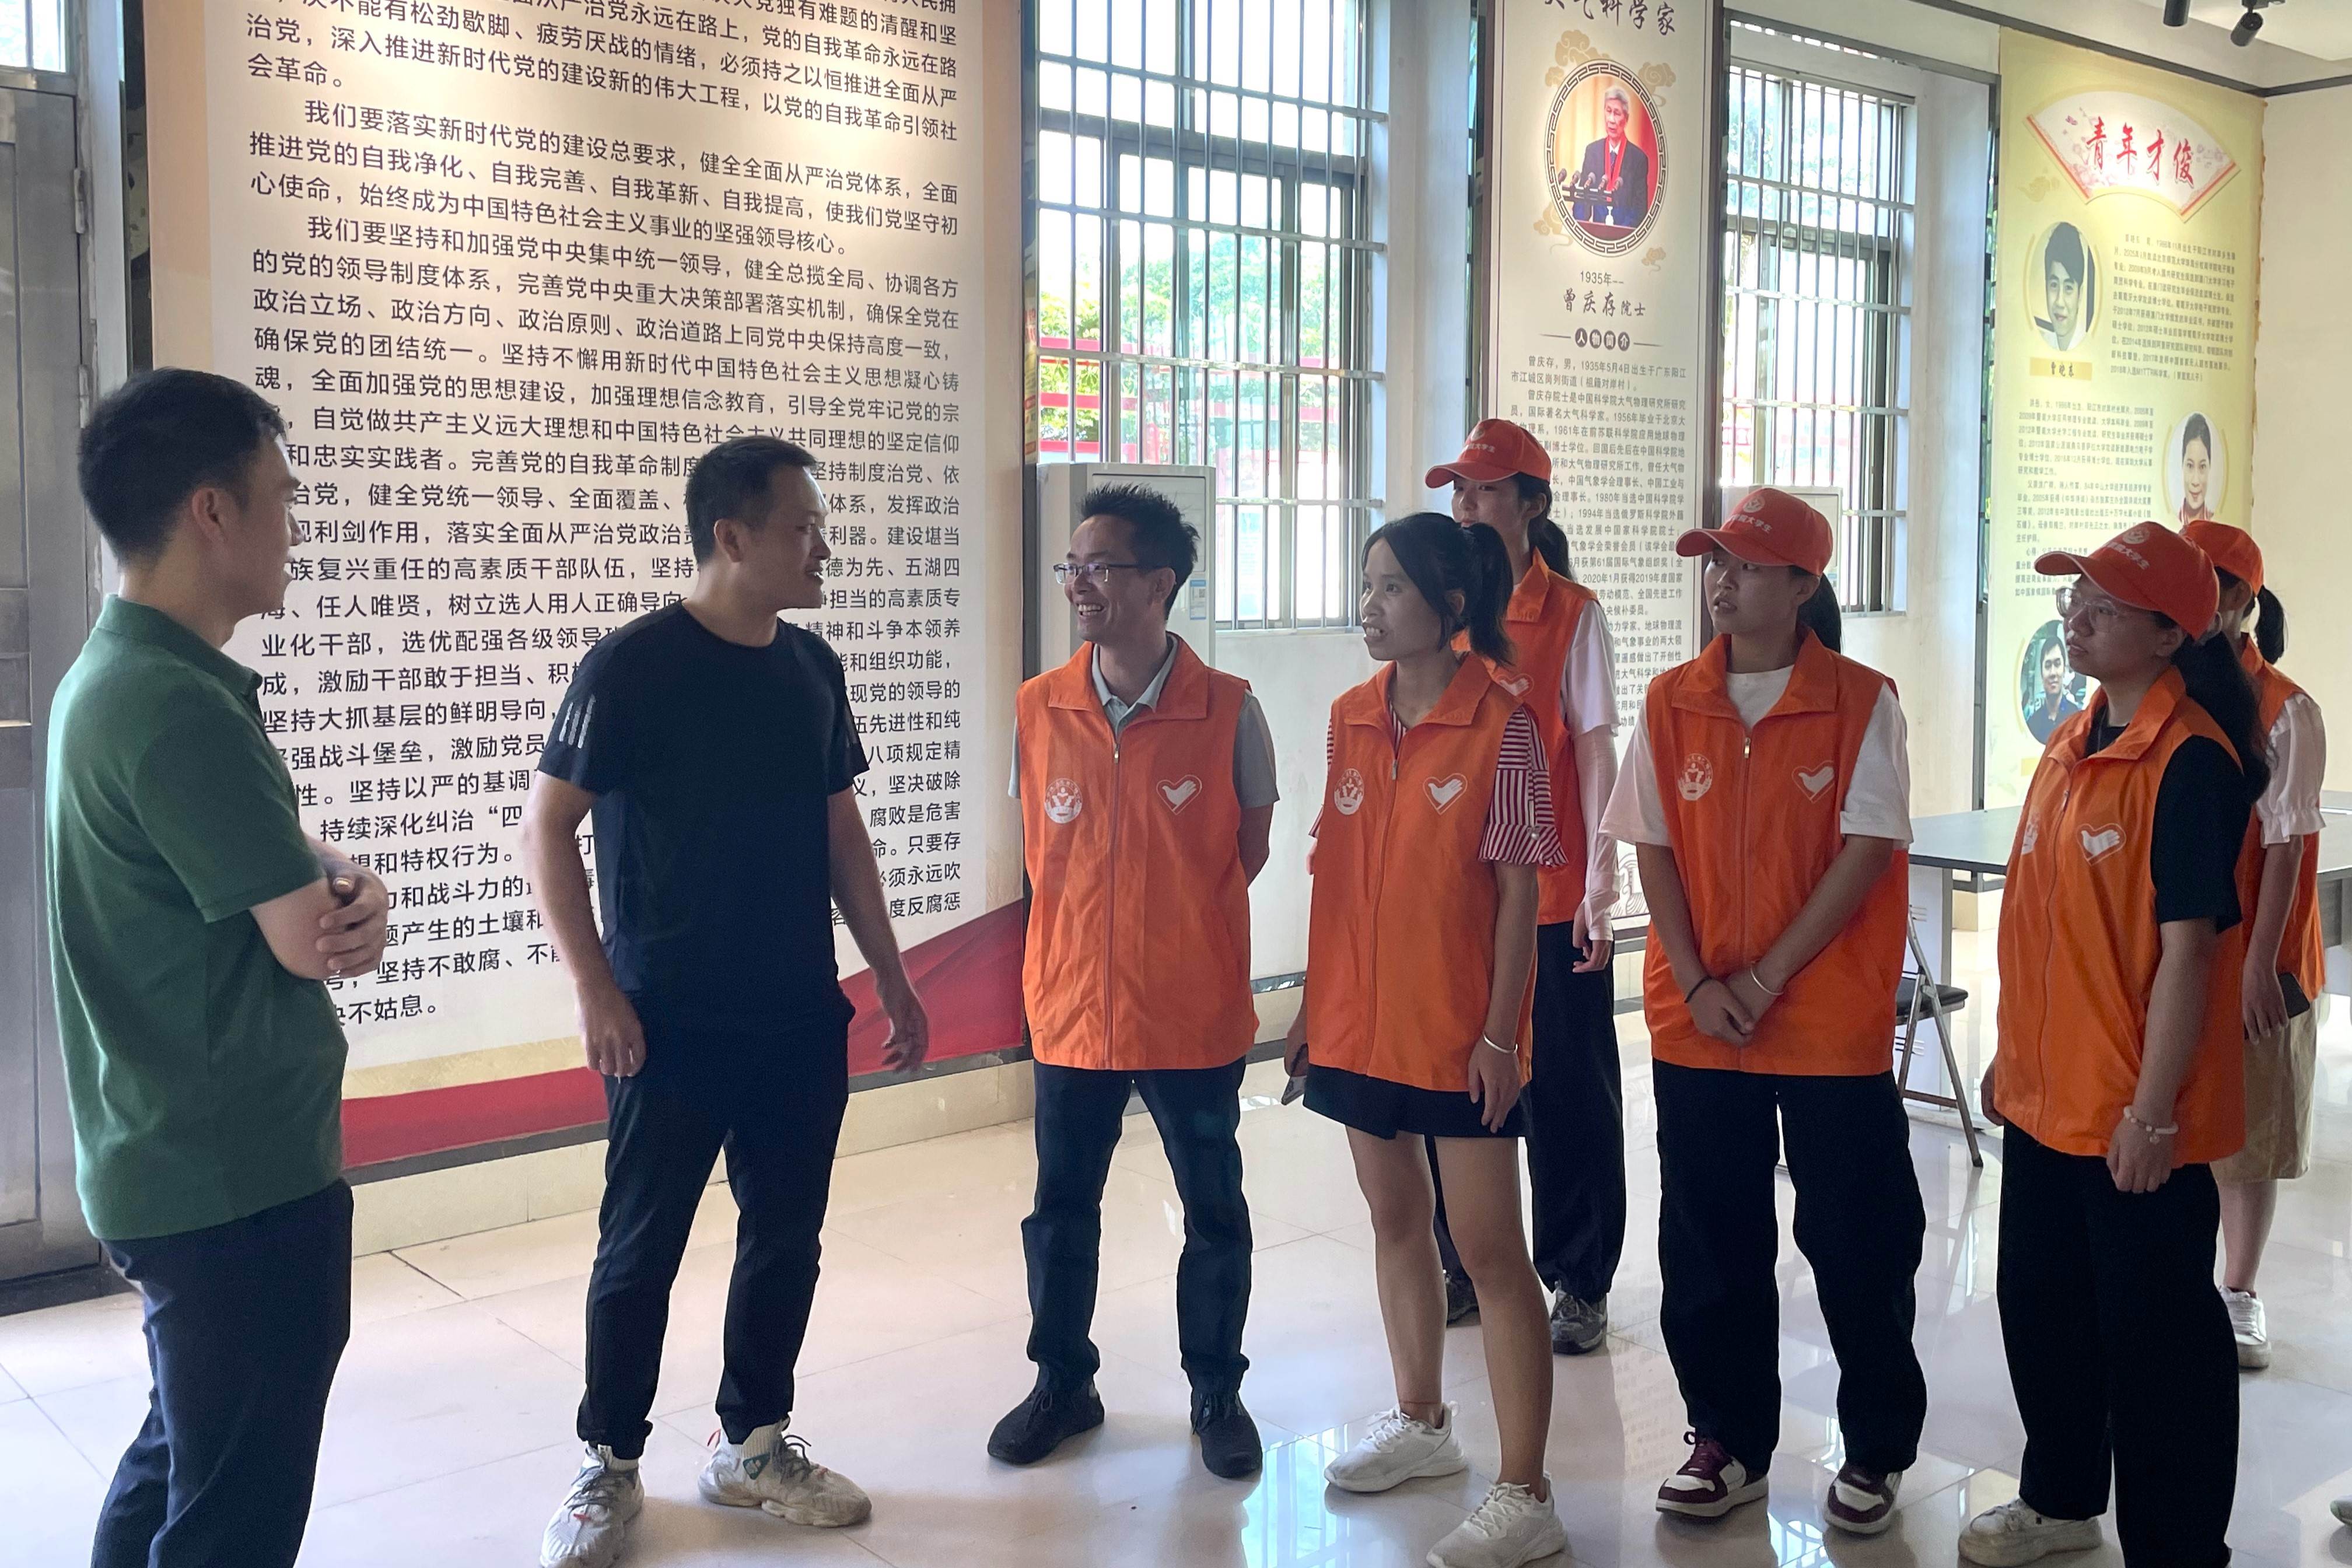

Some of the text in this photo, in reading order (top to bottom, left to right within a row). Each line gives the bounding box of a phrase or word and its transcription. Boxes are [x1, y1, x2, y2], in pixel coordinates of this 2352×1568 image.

[247, 52, 343, 88] 会革命。
[2086, 117, 2194, 187] 青年才俊
[251, 170, 846, 256] 心使命，始终成为中国特色社会主义事业的坚强领导核心。
[1576, 328, 1630, 350] 人物简介
[261, 624, 618, 661] 业化干部，选优配强各级领导
[262, 660, 579, 699] 成，激励干部敢于担当、积
[867, 737, 960, 765] 八项规定精
[869, 798, 960, 828] 腐败是危害
